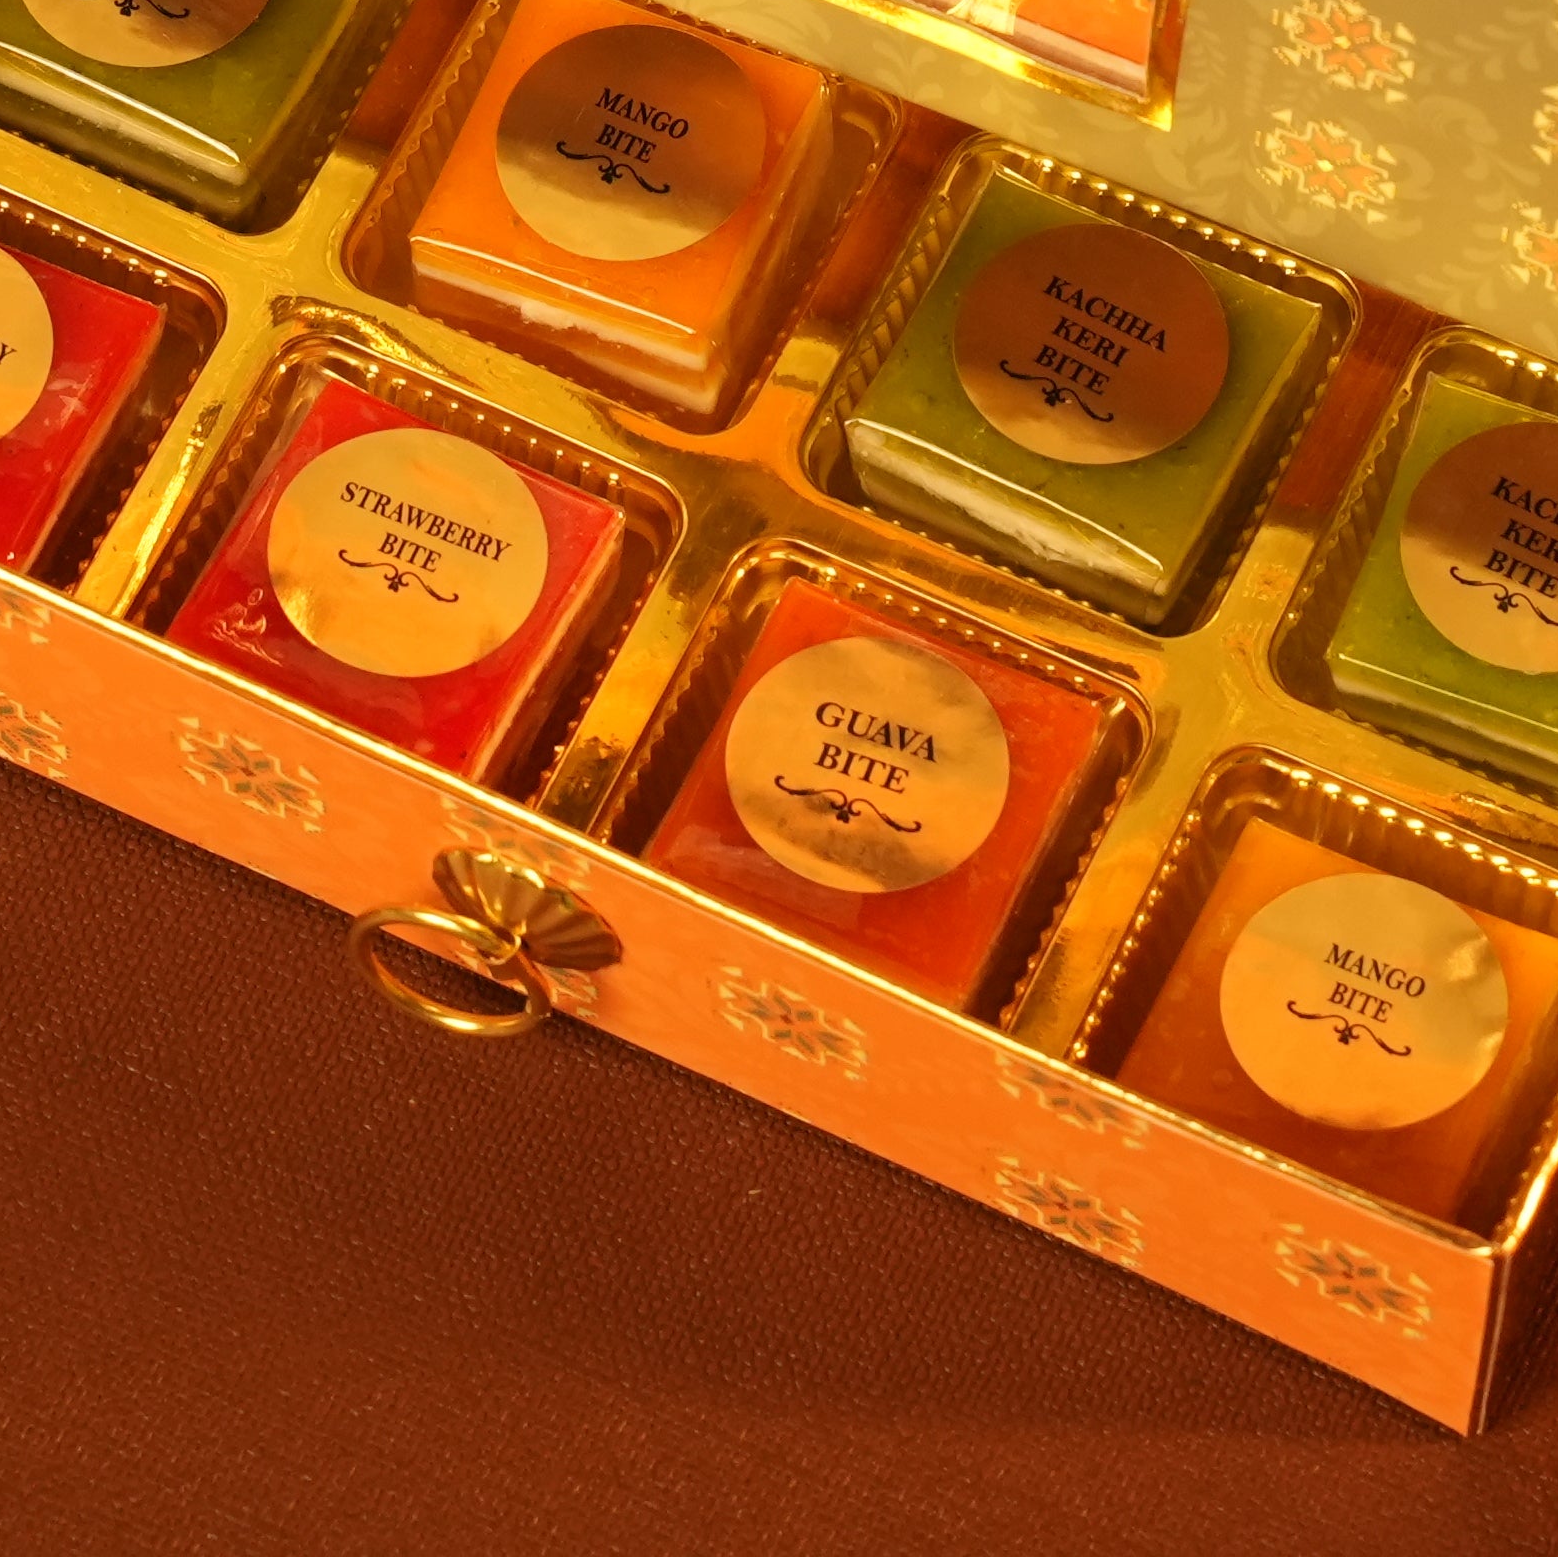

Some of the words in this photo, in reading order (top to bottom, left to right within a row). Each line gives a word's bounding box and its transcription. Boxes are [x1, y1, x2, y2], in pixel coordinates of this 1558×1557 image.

[595, 87, 690, 140] MANGO
[595, 124, 657, 164] BITE
[1043, 275, 1168, 353] KACHHA
[1051, 316, 1132, 368] KERI
[1034, 344, 1111, 397] BITE
[339, 481, 514, 563] STRAWBERRY
[377, 532, 442, 574] BITE
[815, 701, 938, 764] GUAVA
[812, 741, 910, 795] BITE
[1323, 942, 1426, 999] MANGO
[1327, 981, 1393, 1024] BITE
